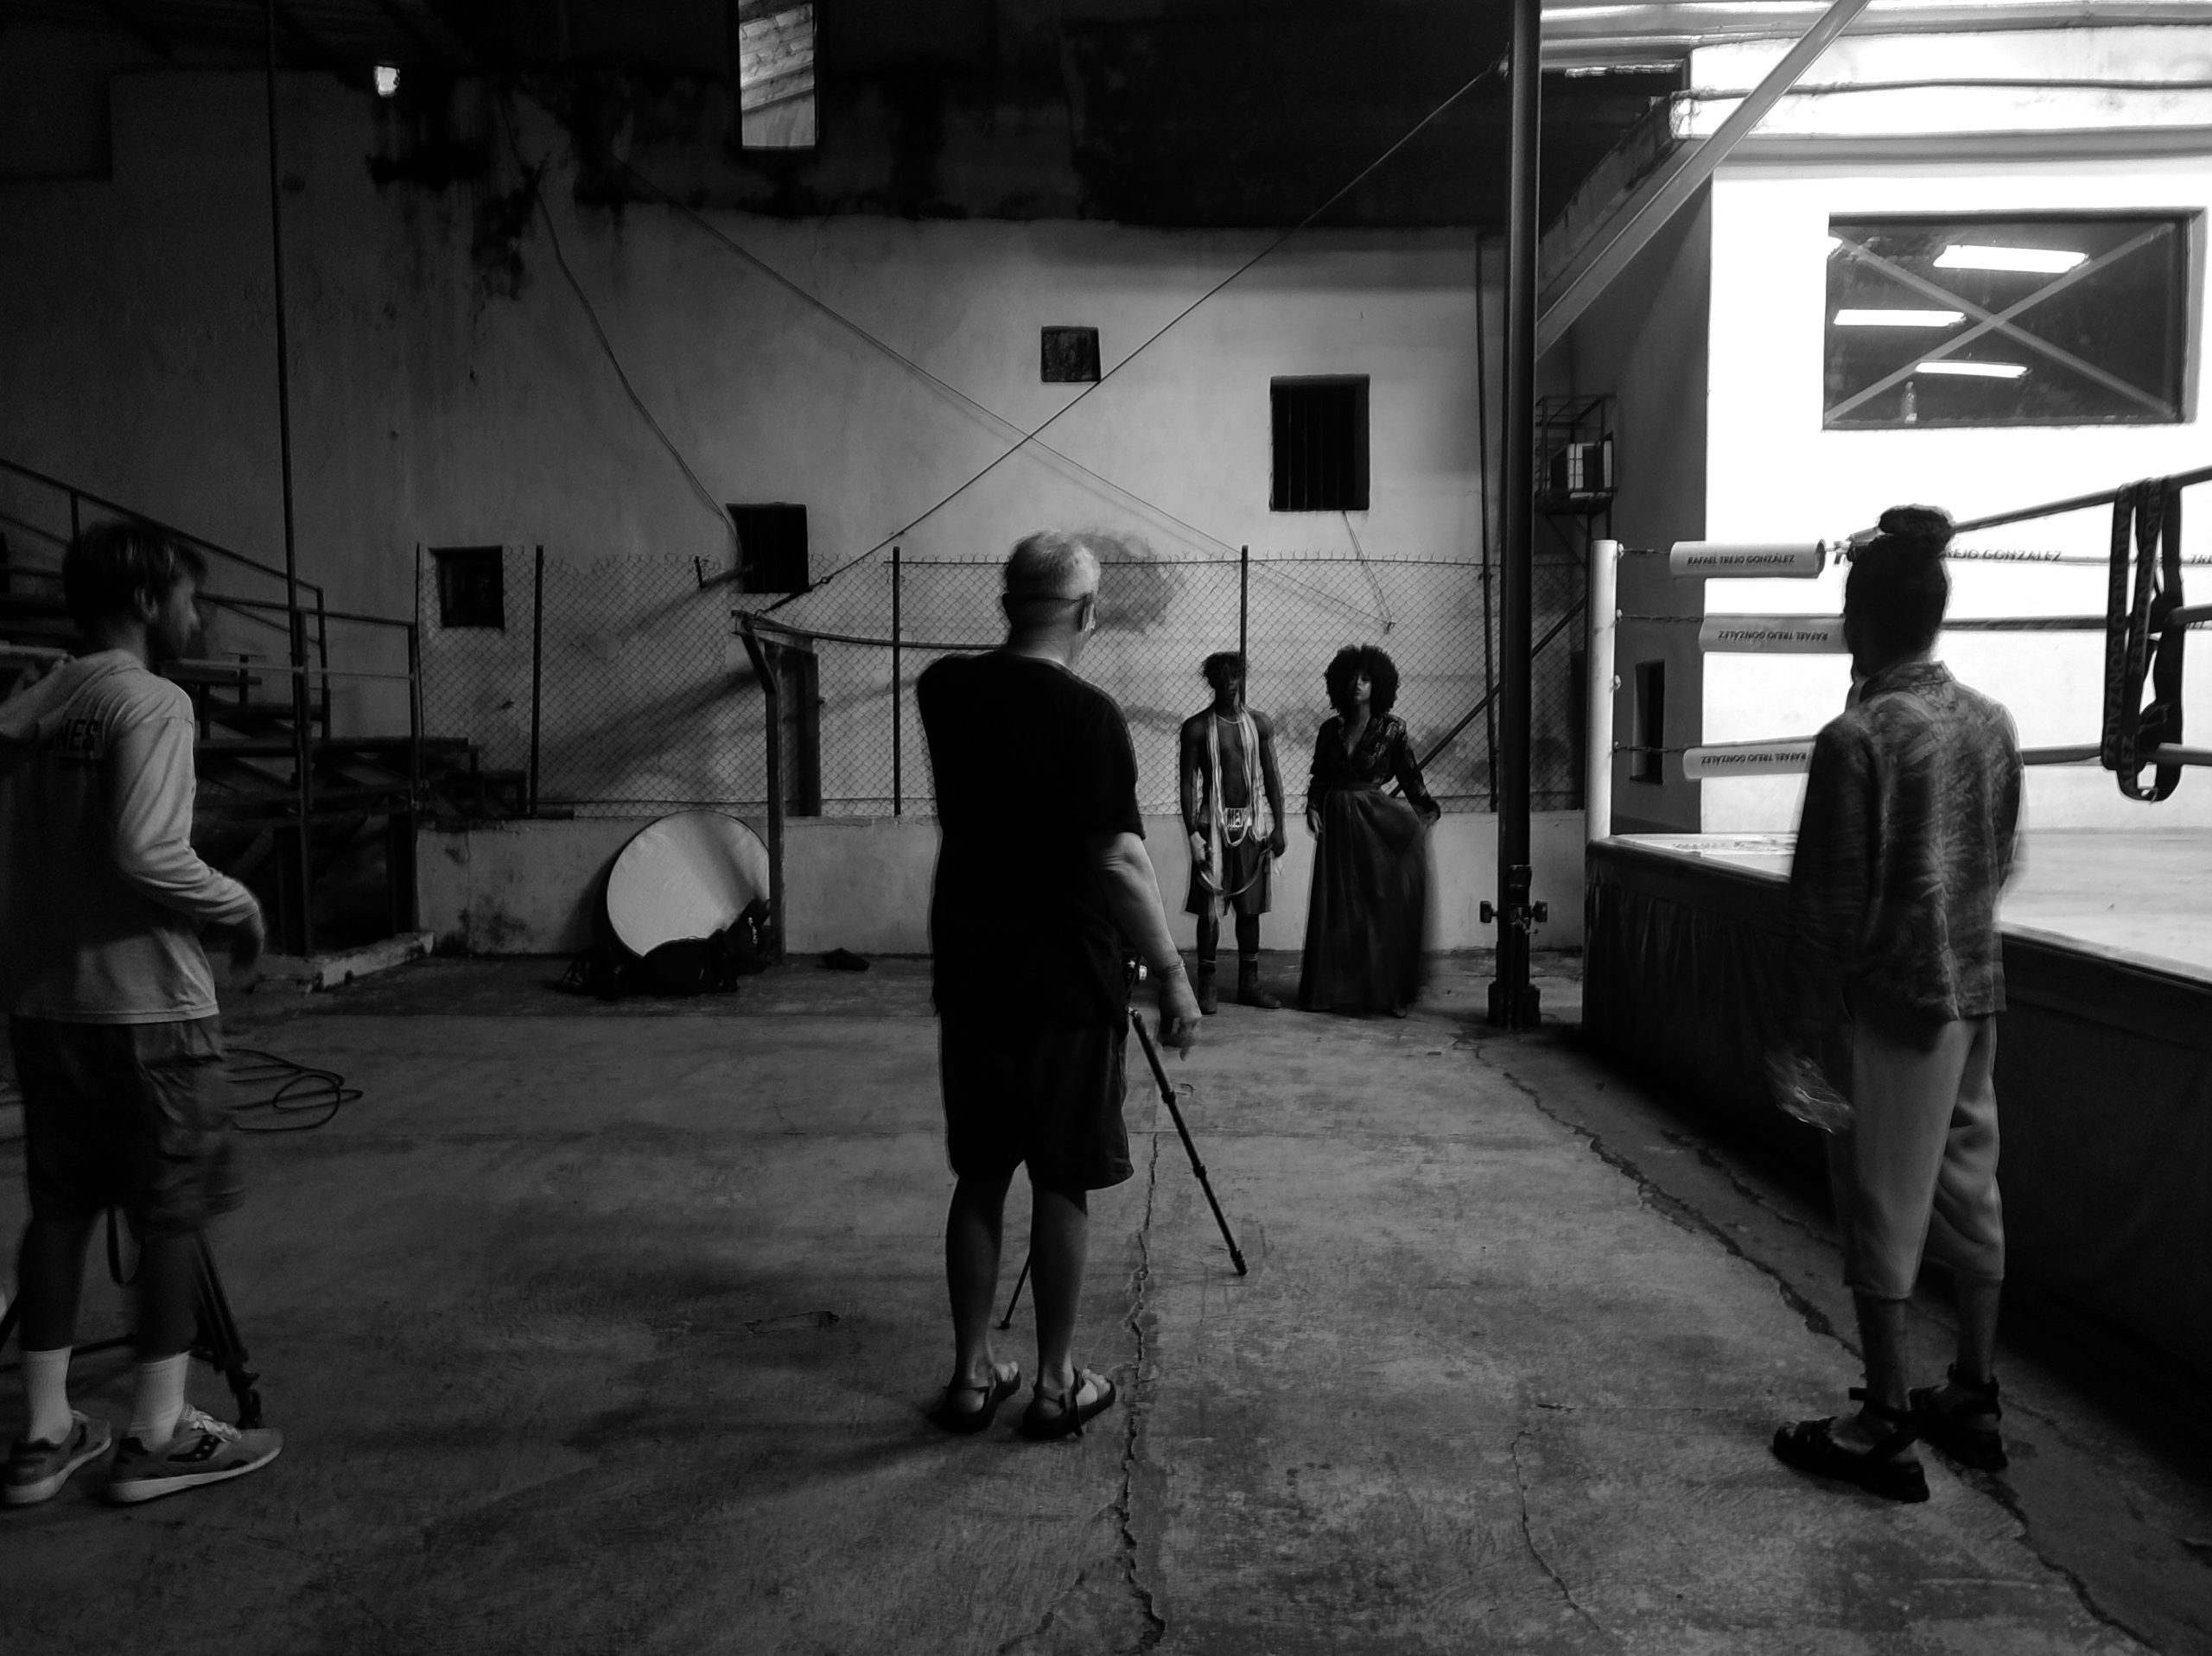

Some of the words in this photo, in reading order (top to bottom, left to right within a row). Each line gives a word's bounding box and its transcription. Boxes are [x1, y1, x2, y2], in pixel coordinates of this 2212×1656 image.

[1688, 556, 1717, 566] RAFAEL
[1719, 555, 1745, 565] TREJO
[1767, 631, 1794, 641] TREJO
[1796, 631, 1828, 641] RAFAEL
[1747, 752, 1773, 763] TREJO
[1776, 752, 1808, 762] RAFAEL
